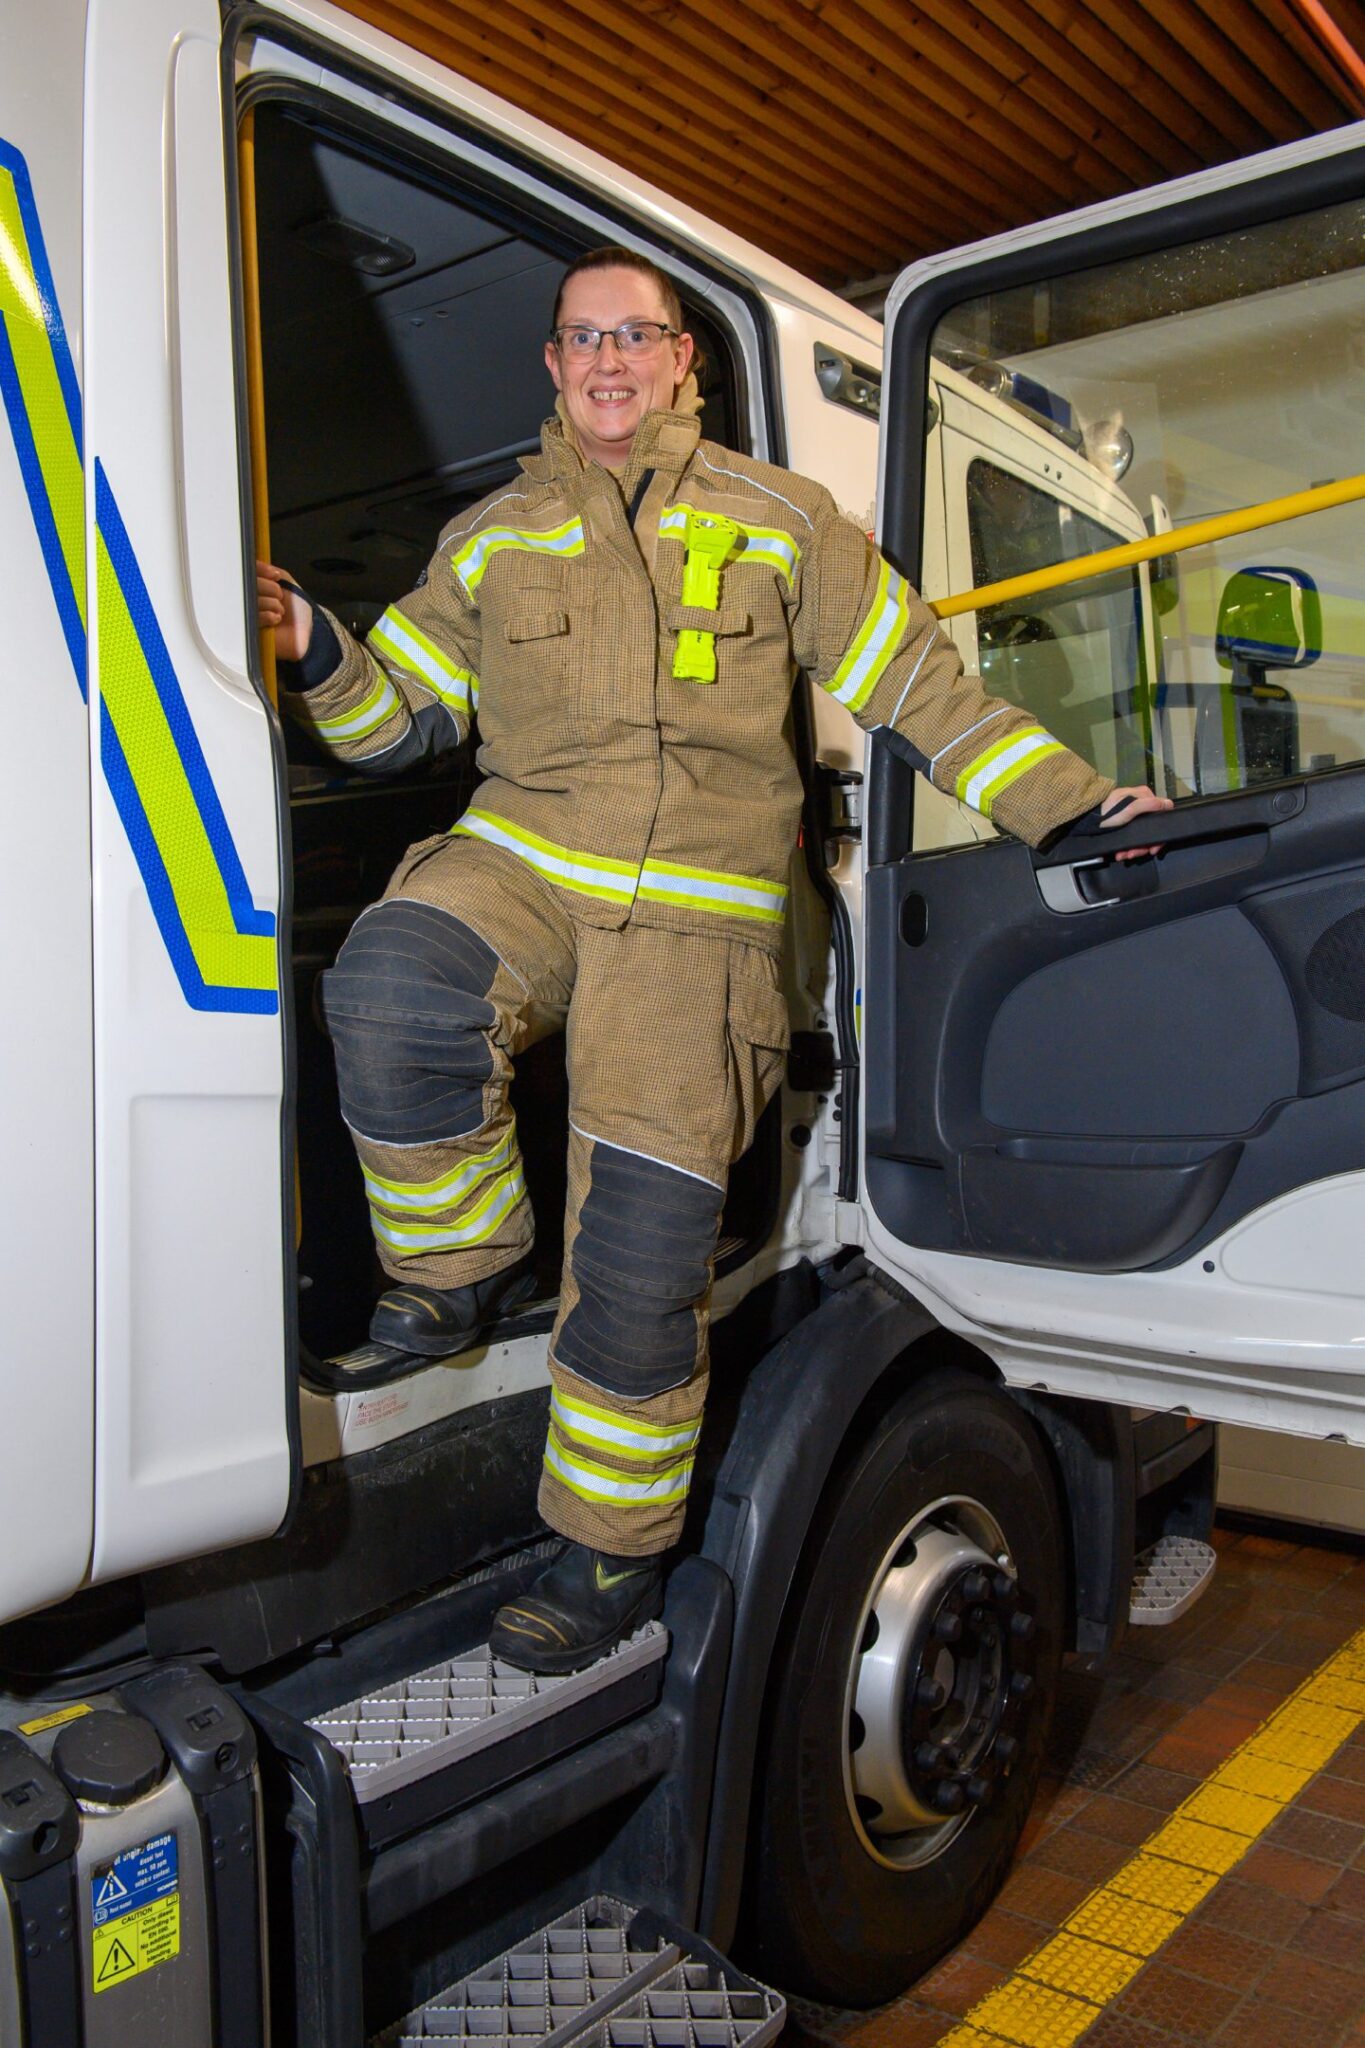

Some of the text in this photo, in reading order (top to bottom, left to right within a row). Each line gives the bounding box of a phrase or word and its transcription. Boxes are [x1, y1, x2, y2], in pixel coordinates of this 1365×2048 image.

[146, 1834, 173, 1852] damage
[121, 1906, 153, 1925] CAUTION
[143, 1908, 174, 1926] Only diesel
[141, 1919, 169, 1934] according
[148, 1930, 157, 1939] EN
[140, 1928, 177, 1950] No additional
[146, 1939, 171, 1955] biodiesel
[147, 1948, 171, 1963] blending
